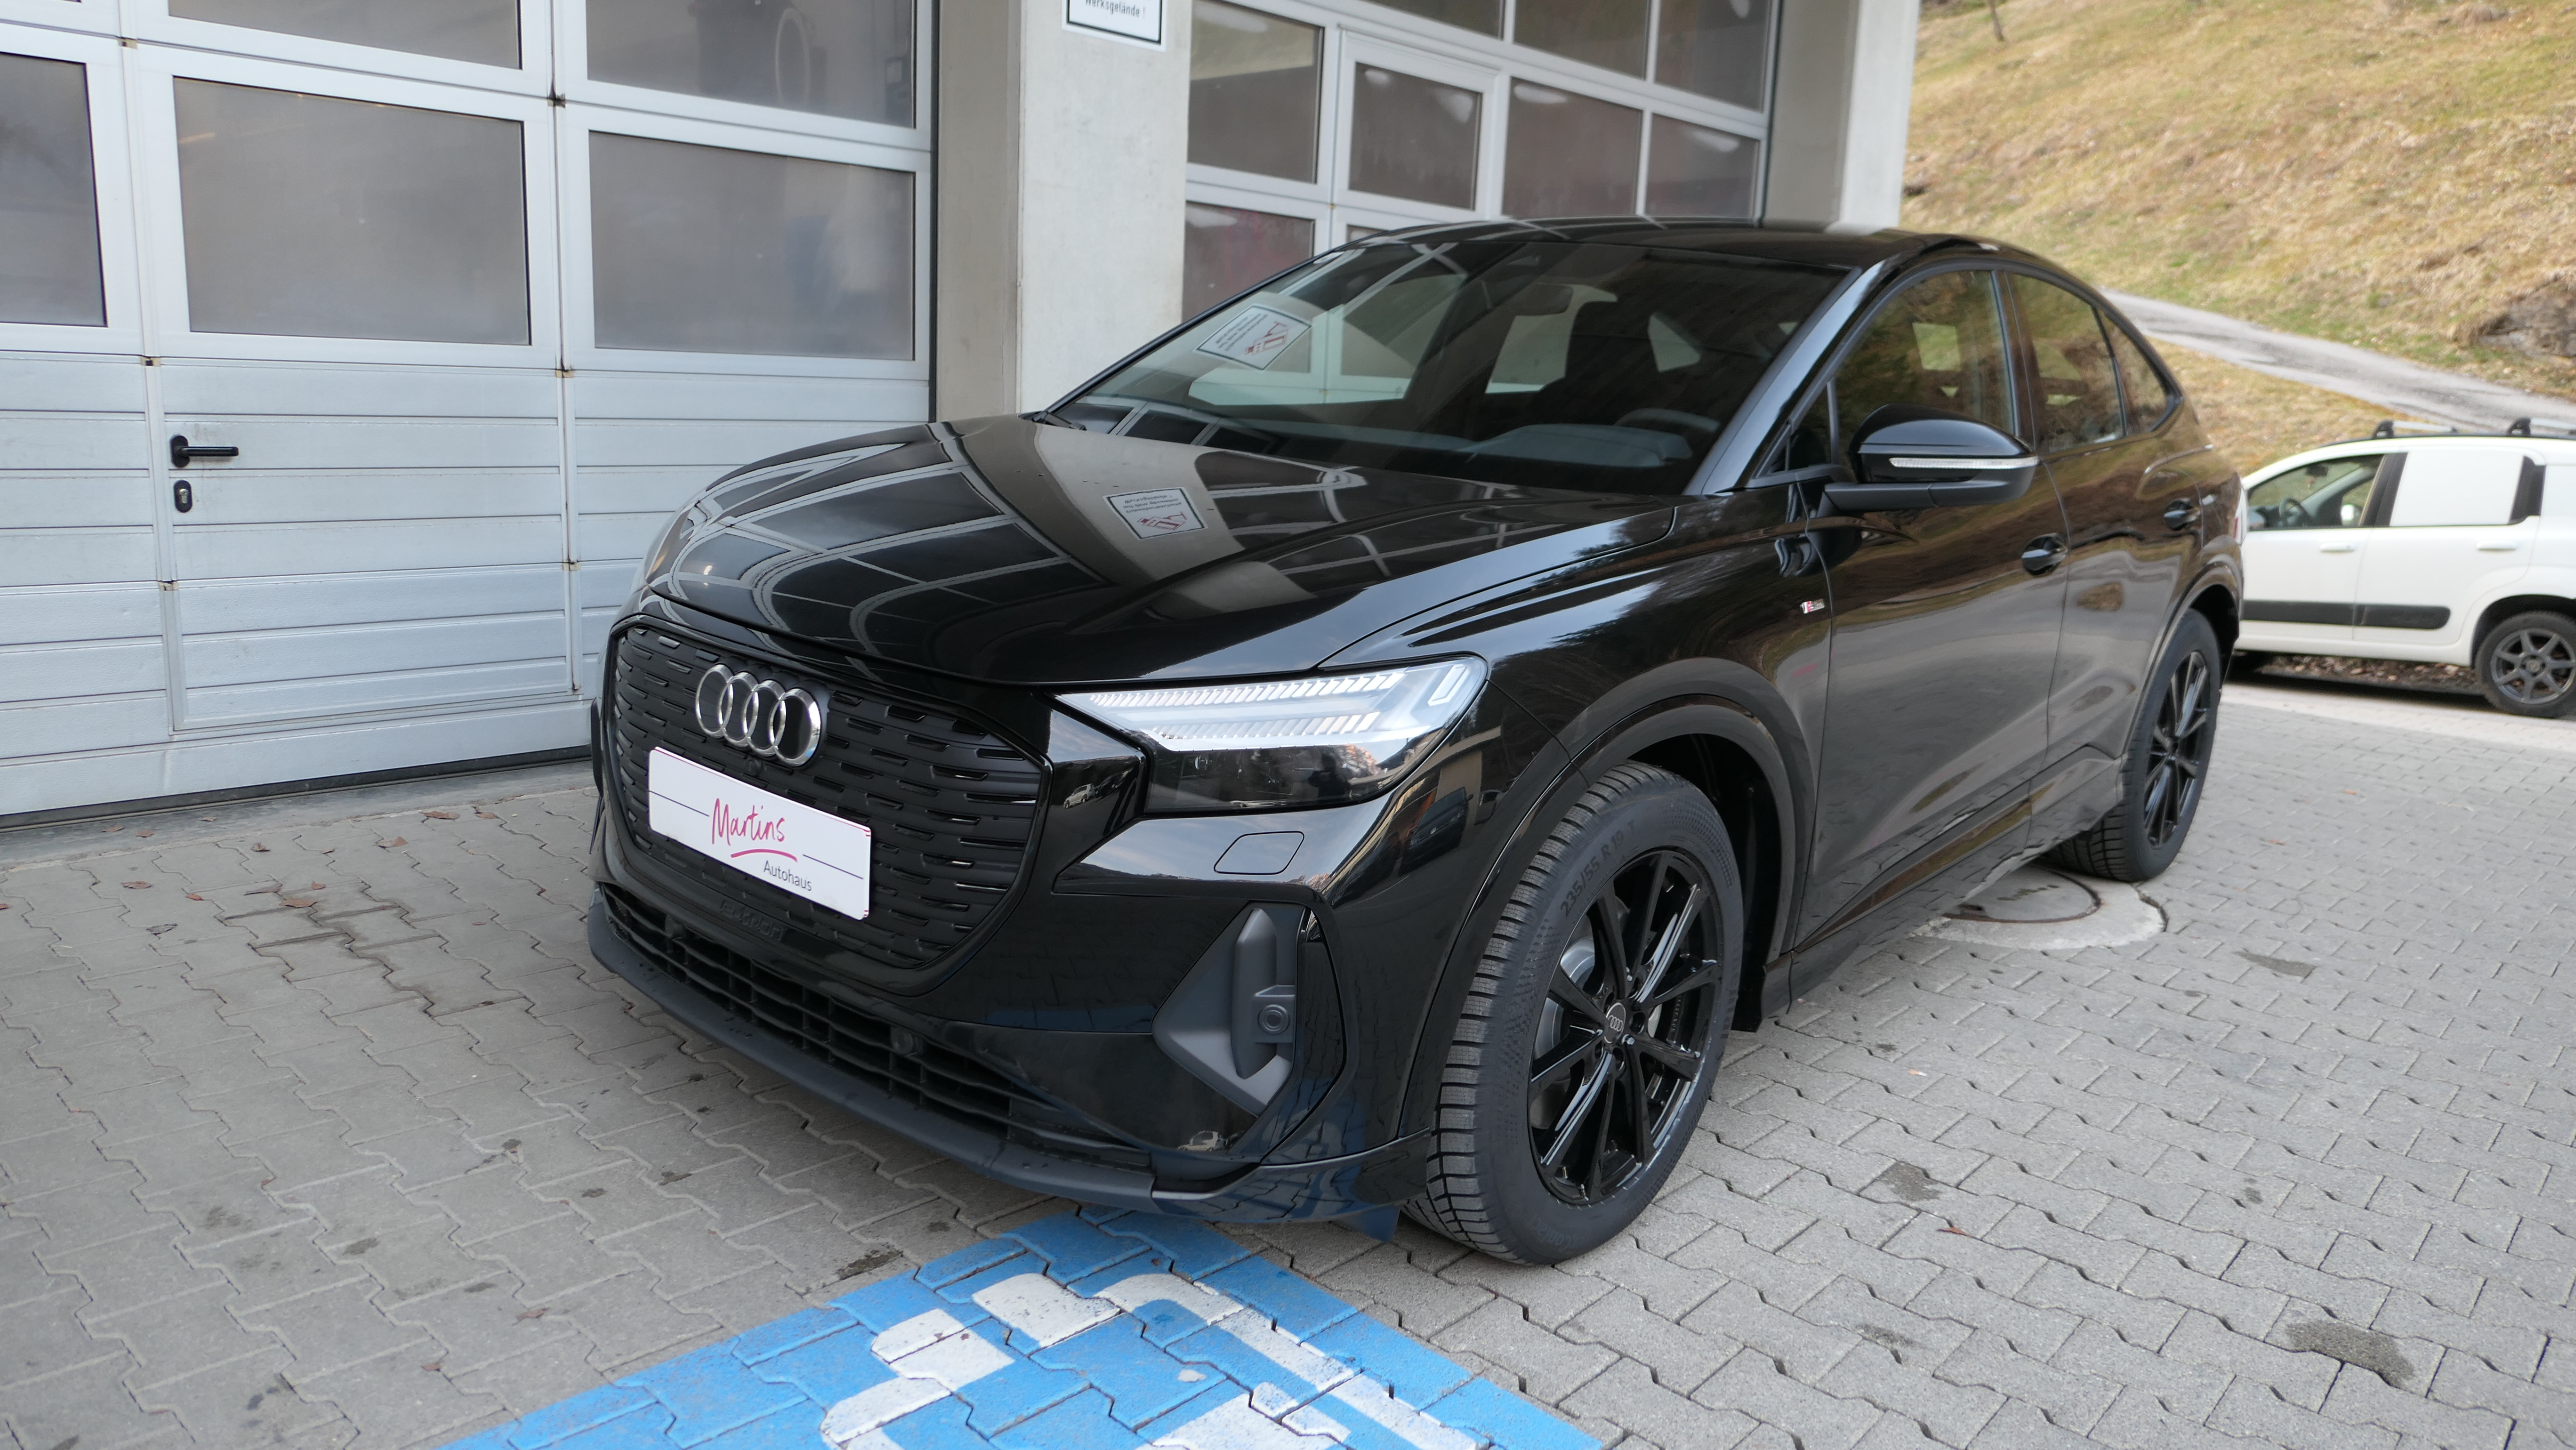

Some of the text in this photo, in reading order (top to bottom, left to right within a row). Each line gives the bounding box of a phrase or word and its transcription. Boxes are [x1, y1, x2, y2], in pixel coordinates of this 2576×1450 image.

[712, 798, 786, 846] Martins
[763, 860, 813, 892] Autohaus
[1560, 855, 1600, 918] 235/55
[1601, 843, 1612, 860] R
[1610, 830, 1624, 850] 19
